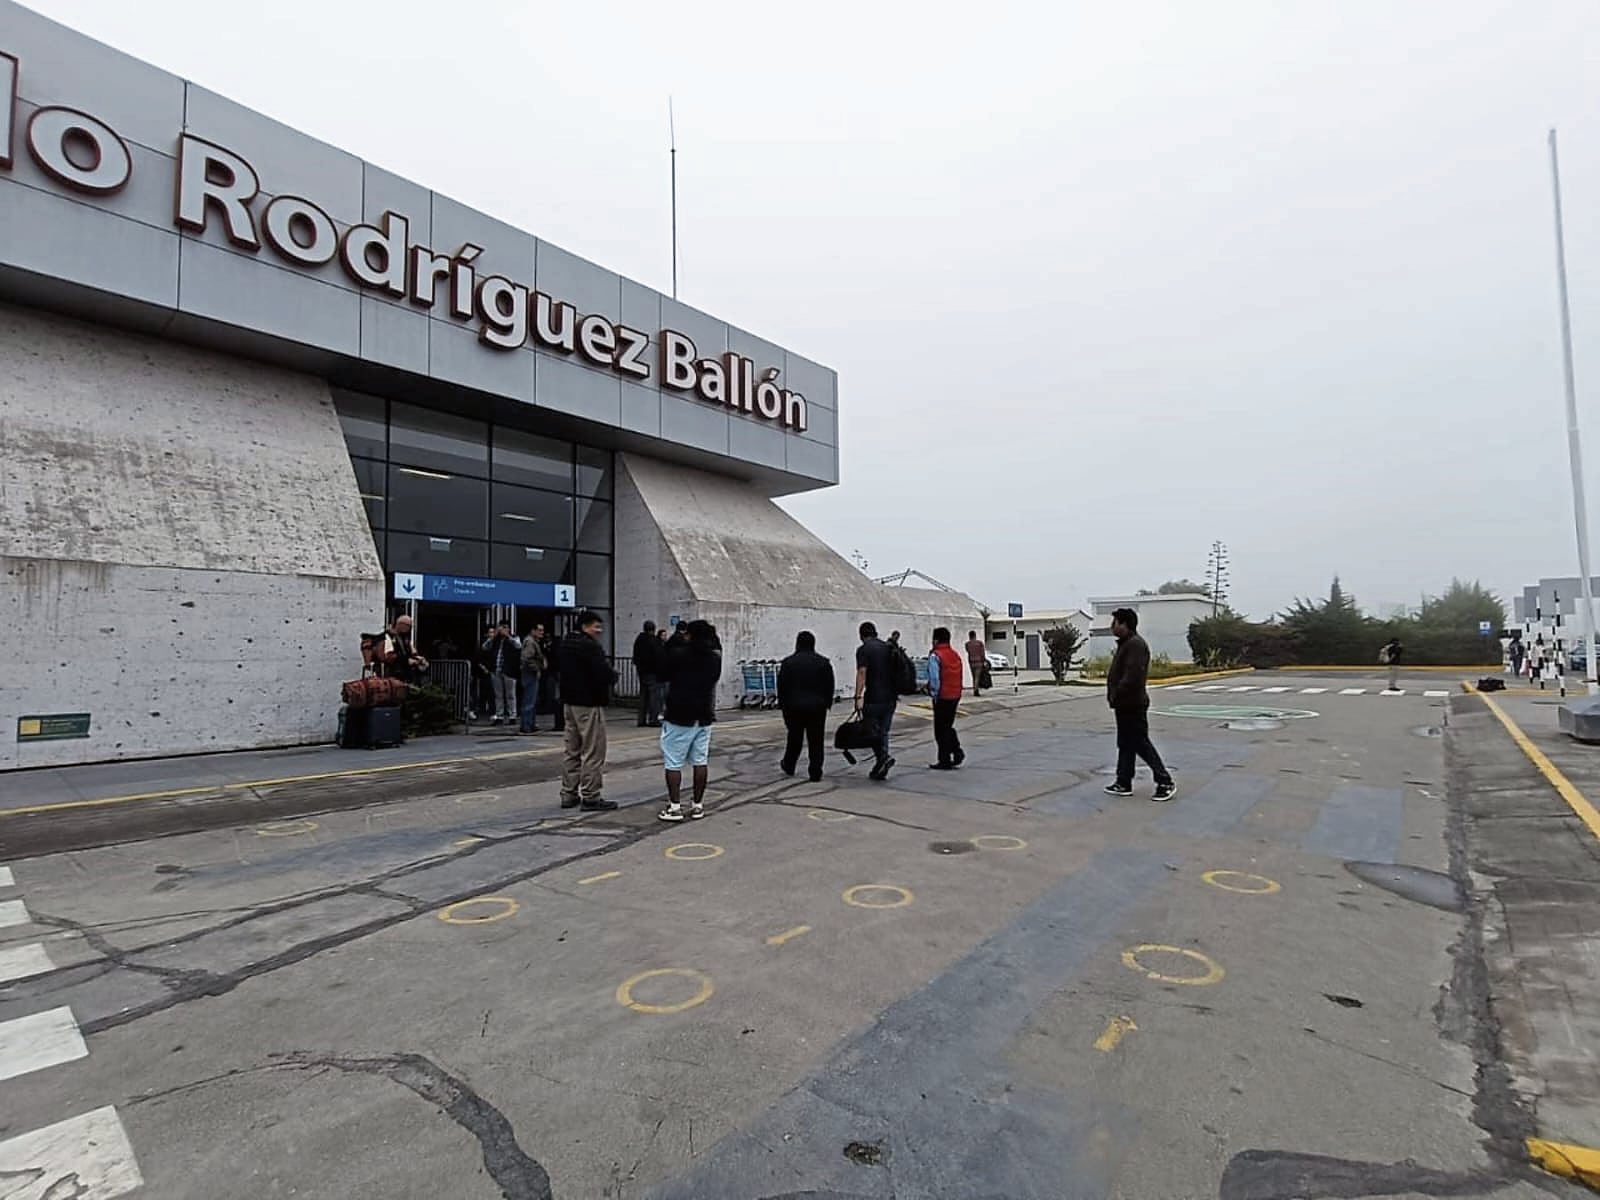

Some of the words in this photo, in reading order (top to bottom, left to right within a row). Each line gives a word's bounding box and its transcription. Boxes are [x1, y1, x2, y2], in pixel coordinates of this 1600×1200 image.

[174, 131, 650, 378] Rodríguez
[660, 328, 808, 431] Ballón
[560, 589, 569, 602] 1
